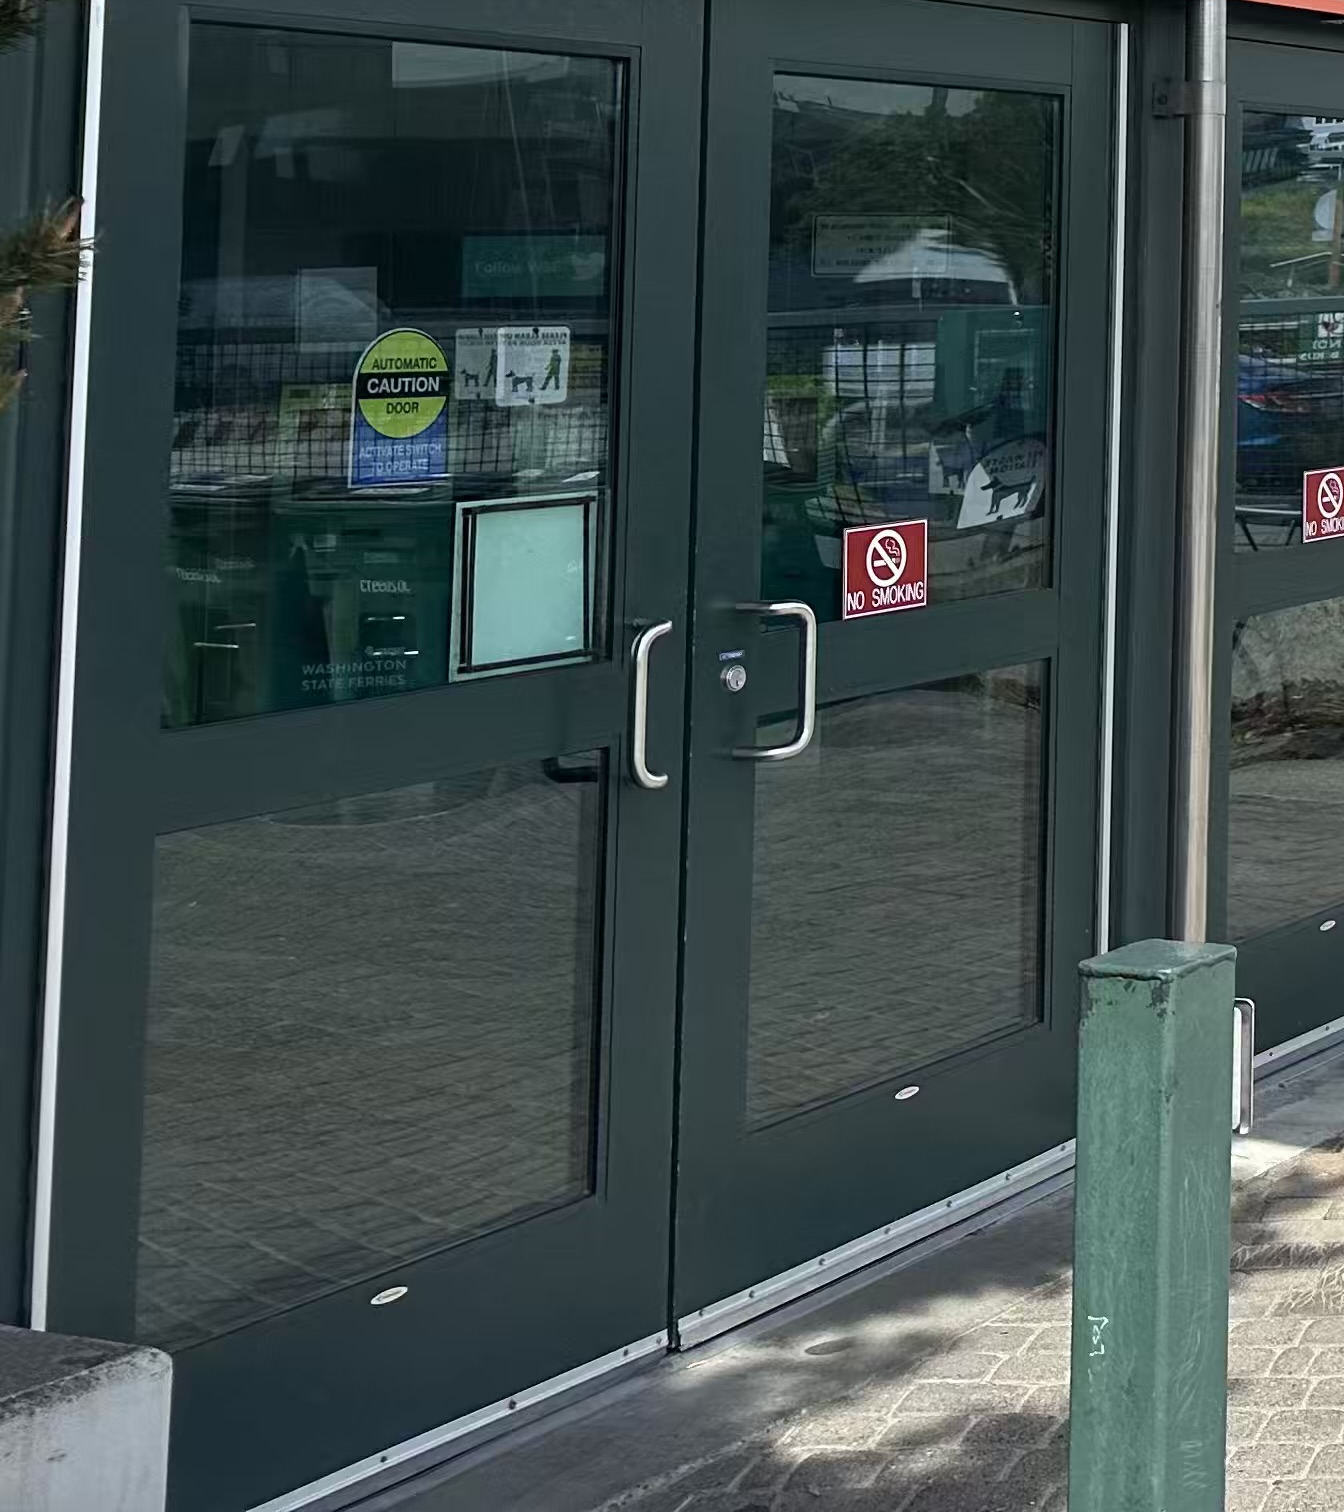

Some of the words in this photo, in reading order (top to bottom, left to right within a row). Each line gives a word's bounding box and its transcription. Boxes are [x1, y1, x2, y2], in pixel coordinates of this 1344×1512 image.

[372, 357, 437, 371] AUTOMATIC
[367, 376, 440, 394] CAUTION
[386, 402, 418, 414] DOOR
[359, 444, 404, 459] ACTIVATE
[406, 442, 442, 456] SWITCH
[386, 458, 428, 473] OPERATE
[1304, 520, 1318, 536] NO
[848, 590, 865, 612] NO
[872, 582, 924, 608] SMOKING
[302, 660, 407, 676] WASHINGTON
[302, 678, 344, 692] STATE
[348, 674, 406, 689] FERRIES
